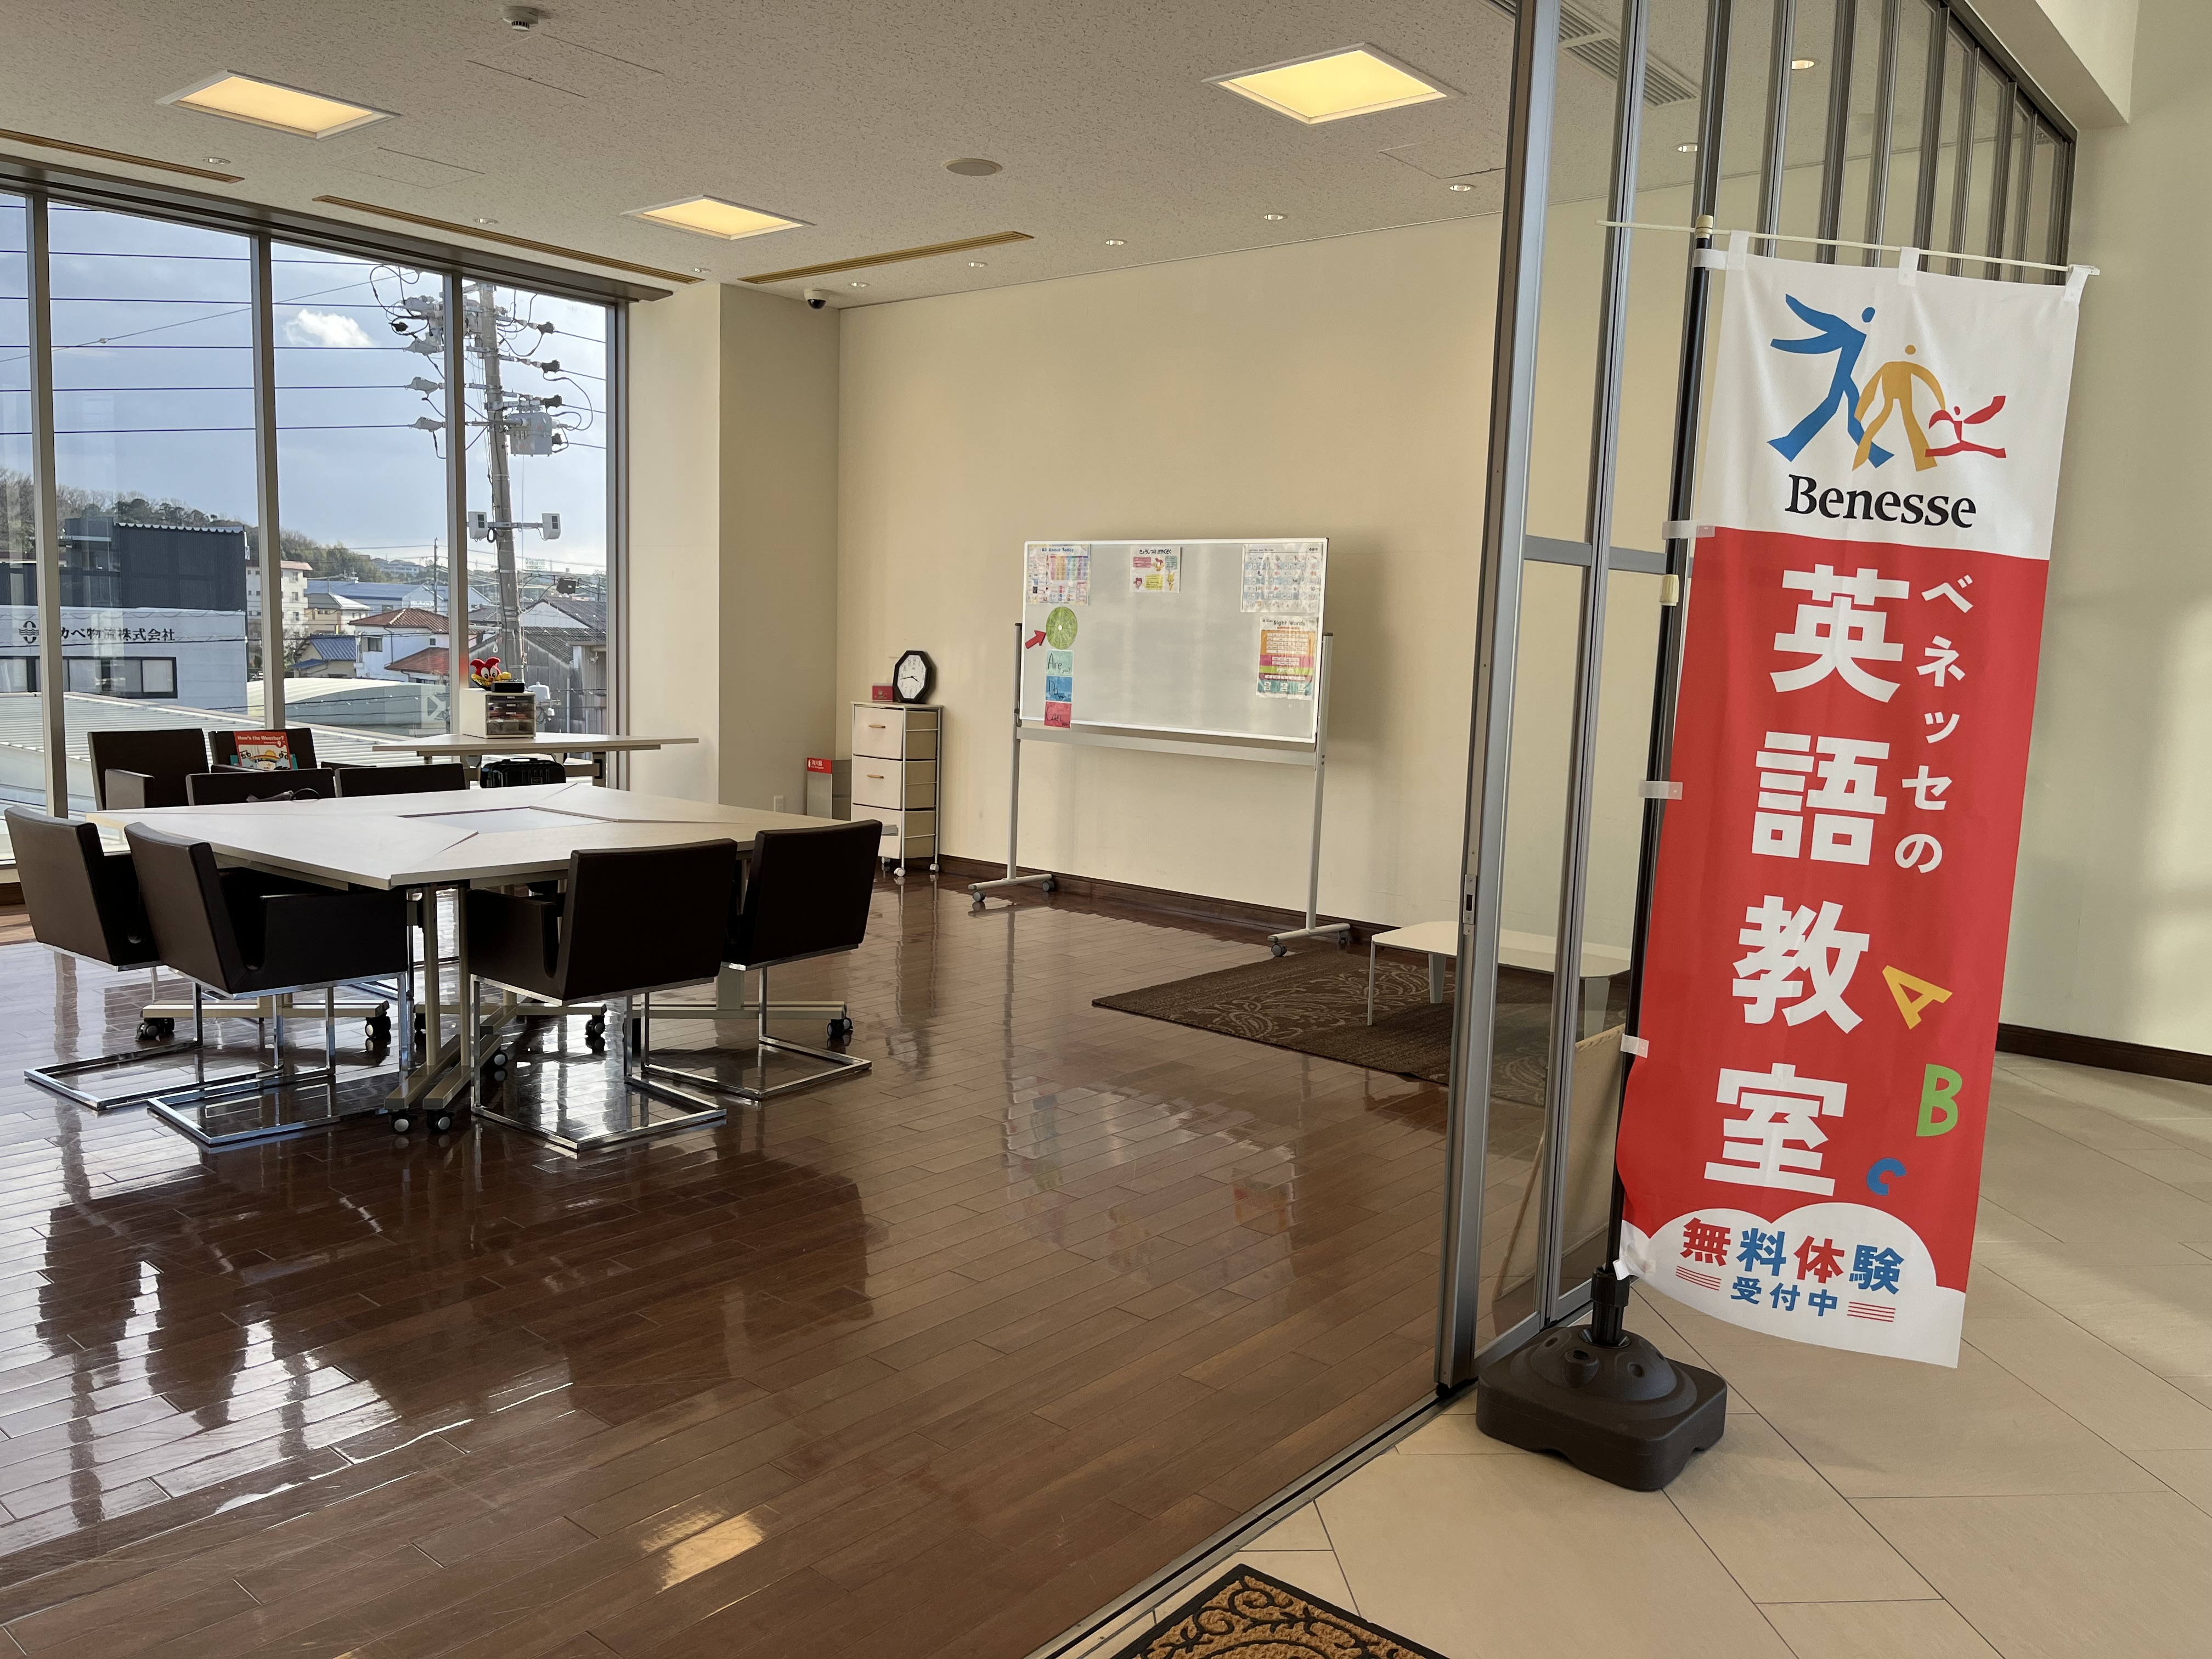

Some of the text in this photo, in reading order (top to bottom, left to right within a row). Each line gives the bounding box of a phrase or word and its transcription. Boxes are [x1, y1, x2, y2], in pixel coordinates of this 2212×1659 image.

[1785, 473, 1976, 528] Benesse
[1048, 653, 1063, 670] Are
[1048, 680, 1058, 696] Do
[1046, 706, 1062, 721] Can
[1894, 574, 1973, 873] ベネッセの
[1703, 563, 1910, 1197] 英語教室
[1882, 965, 1953, 1029] A
[1916, 1064, 1963, 1137] B
[1680, 1217, 1904, 1295] 無料体験
[1730, 1276, 1838, 1317] 受付中
